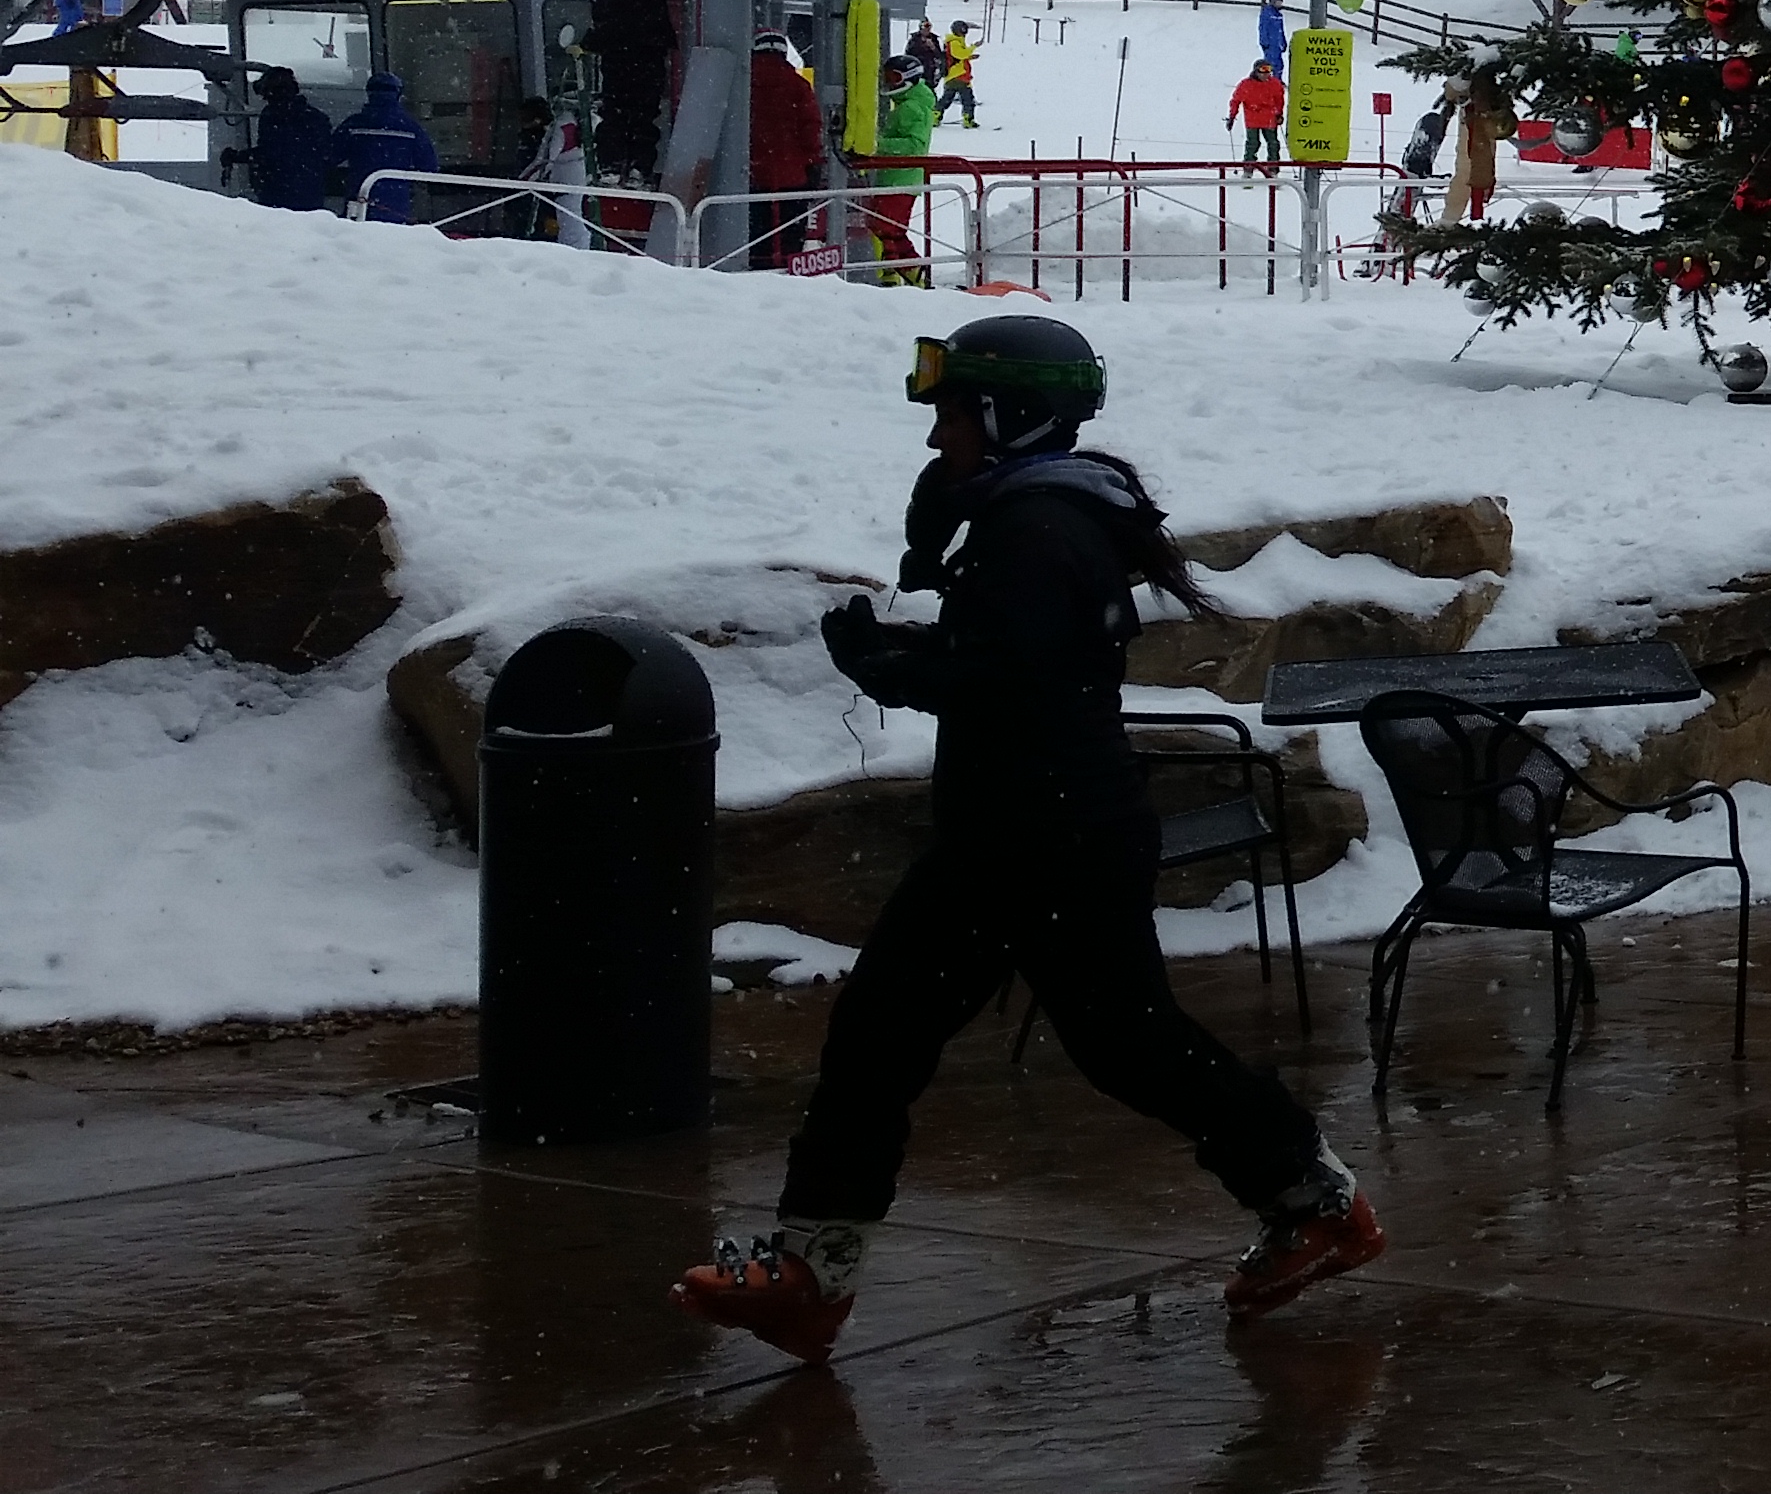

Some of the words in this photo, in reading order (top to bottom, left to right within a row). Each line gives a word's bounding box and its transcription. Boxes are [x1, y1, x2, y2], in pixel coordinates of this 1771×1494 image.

[1308, 37, 1342, 46] WHAT
[1306, 47, 1344, 56] MAKES
[1312, 57, 1336, 66] YOU
[1309, 67, 1340, 76] EPIC?
[792, 249, 840, 276] CLOSED
